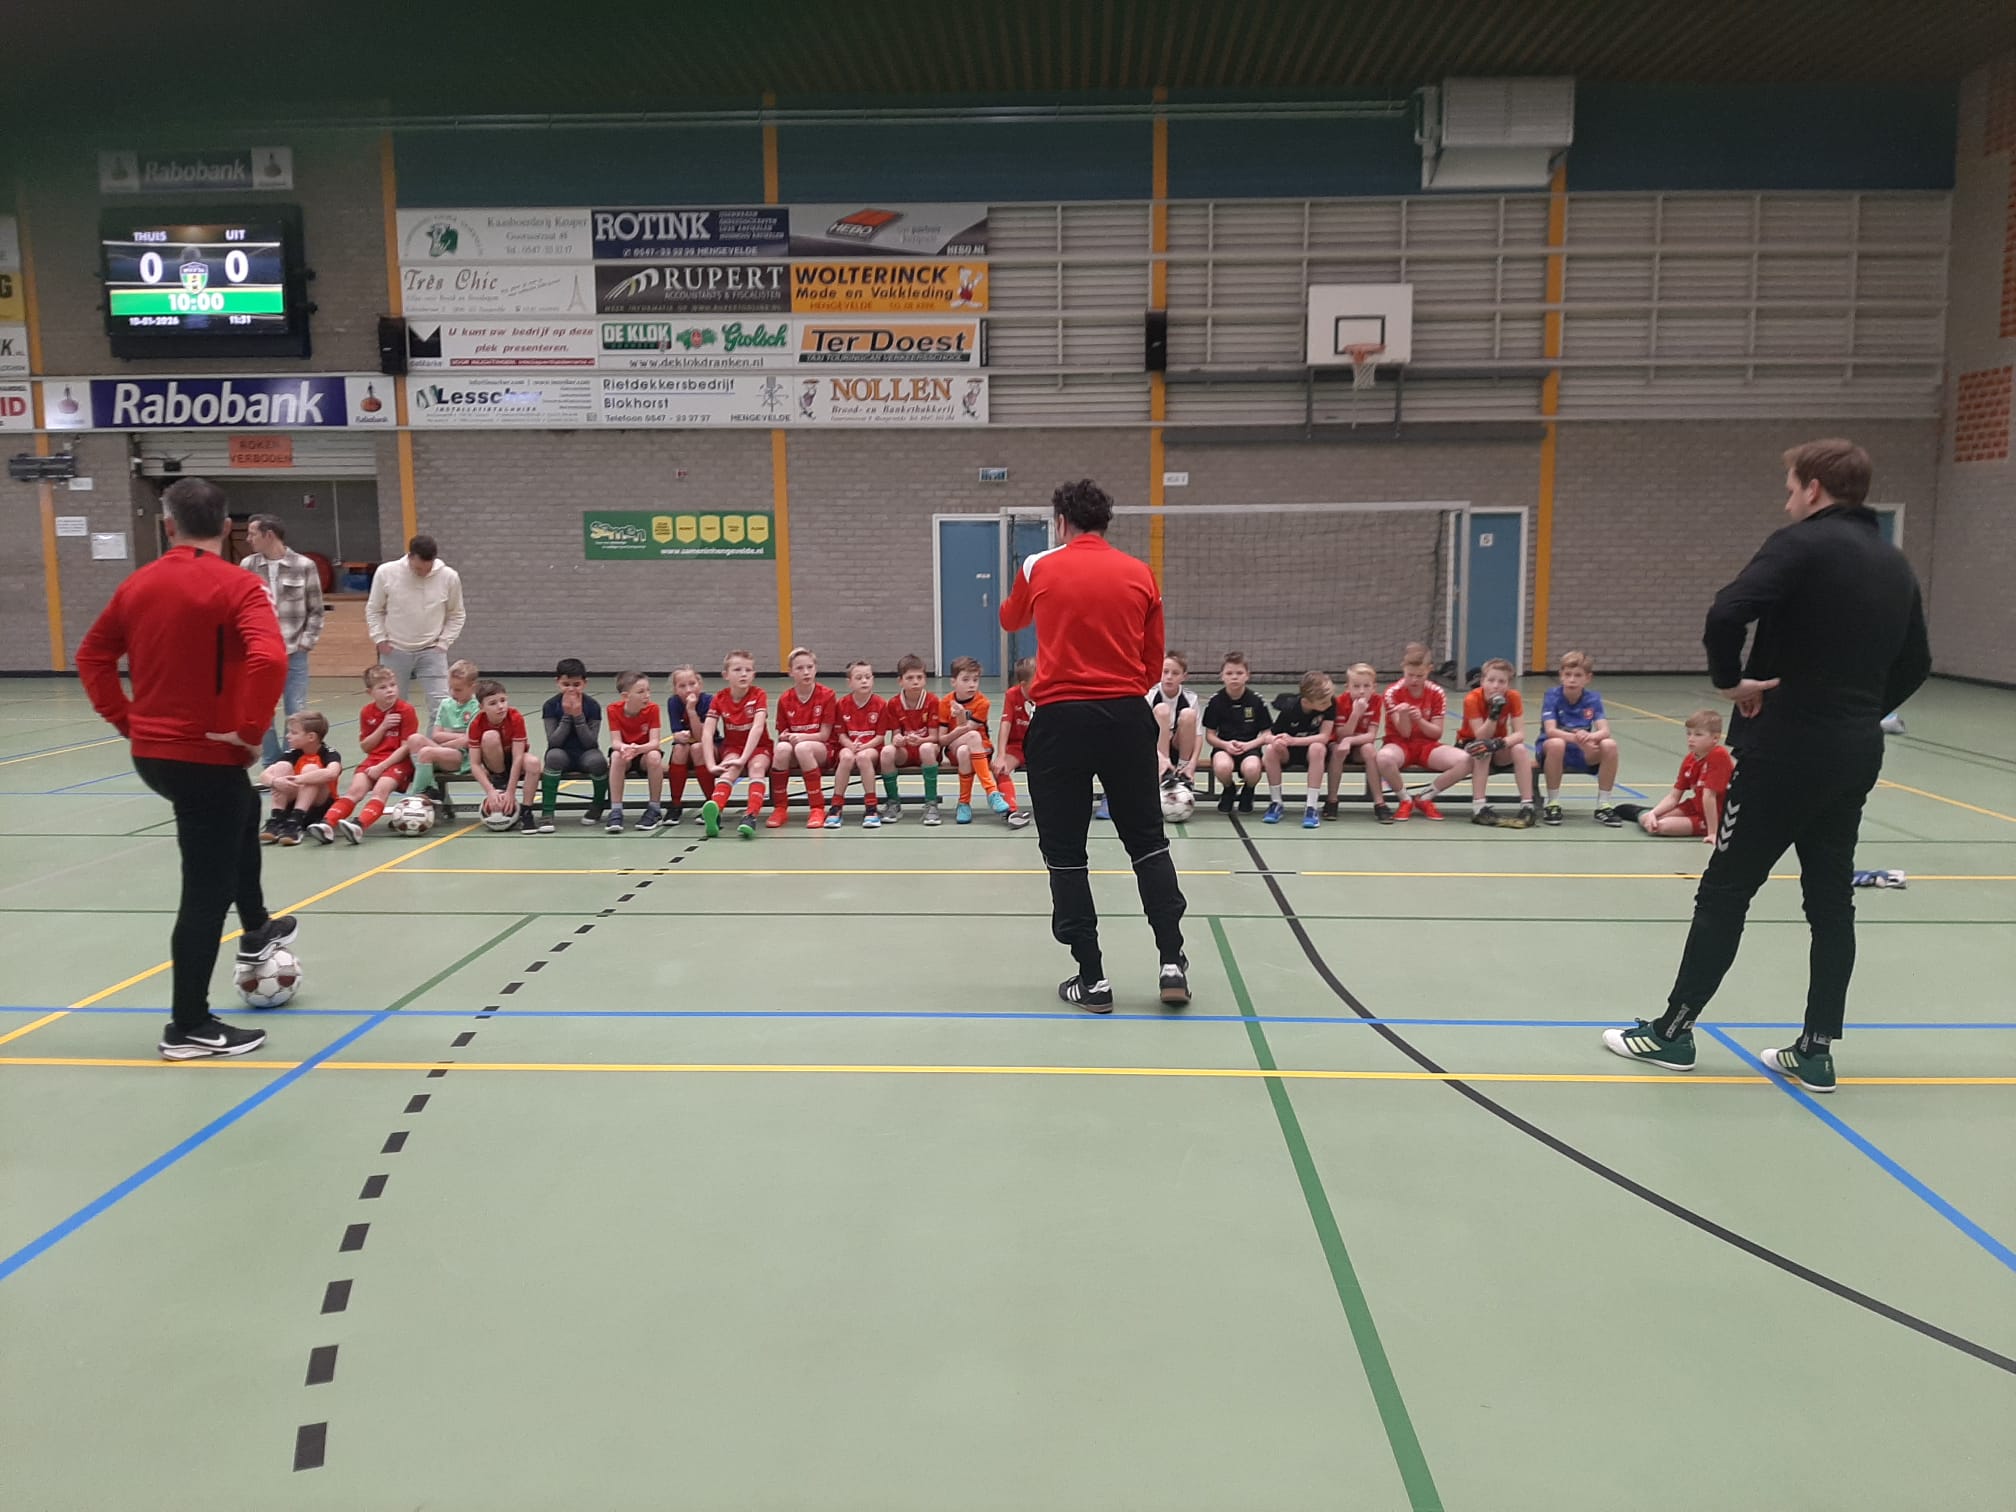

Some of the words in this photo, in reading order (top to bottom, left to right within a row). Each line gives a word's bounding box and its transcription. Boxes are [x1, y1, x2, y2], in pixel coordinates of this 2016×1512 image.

[145, 160, 245, 182] Rabobank
[595, 212, 711, 240] ROTINK
[831, 223, 873, 236] HEBO
[134, 231, 167, 241] THUIS
[225, 230, 245, 239] UIT
[698, 246, 758, 257] HENGEVELDE
[140, 252, 163, 284] 0
[225, 250, 248, 282] 0
[795, 266, 950, 284] WOLTERINCK
[455, 268, 499, 290] Chic
[664, 267, 783, 290] RUPERT
[168, 293, 224, 311] 10:00
[795, 287, 837, 299] Mode
[845, 289, 862, 298] en
[869, 286, 954, 301] Vakkleding
[448, 328, 457, 336] U
[462, 327, 485, 336] kunt
[512, 327, 549, 338] bedrijf
[552, 328, 566, 337] op
[569, 328, 594, 336] deze
[604, 325, 624, 342] DE
[628, 325, 669, 342] KLOK
[721, 322, 787, 351] Grolsch
[810, 330, 858, 352] Ter
[866, 330, 966, 352] Doest
[475, 343, 497, 353] plek
[502, 343, 569, 354] presenteren.
[629, 356, 765, 368] www.deklokdranken.nl
[603, 378, 735, 394] Rietdekkersbedrijf
[831, 378, 953, 402] NOLLEN
[112, 382, 326, 425] Rabobank
[437, 387, 542, 405] Lessc
[604, 398, 668, 409] Blokhorst
[605, 414, 643, 422] Telefoon
[730, 414, 790, 422] HENGEVELDE
[230, 451, 292, 463] VERBODEN
